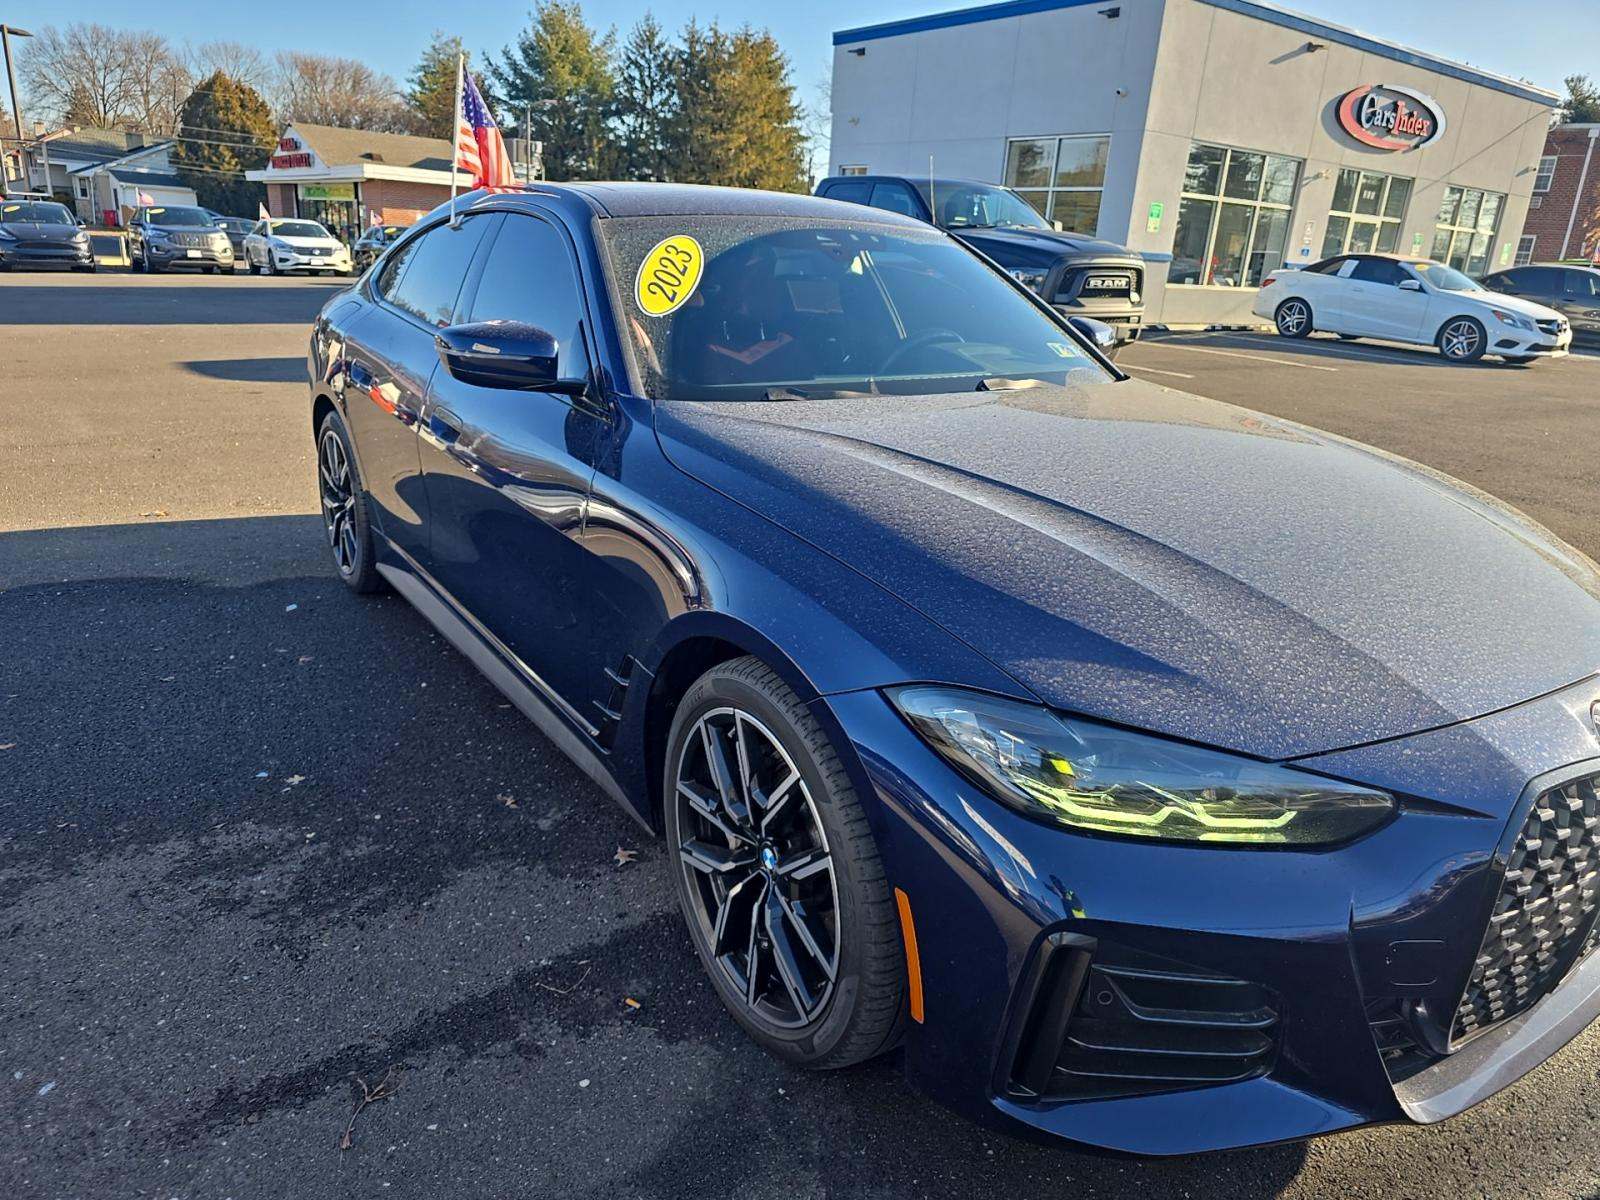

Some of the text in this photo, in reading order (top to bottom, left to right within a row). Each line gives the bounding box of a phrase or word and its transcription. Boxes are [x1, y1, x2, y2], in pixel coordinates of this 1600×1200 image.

[1361, 93, 1431, 137] CarsIndex
[647, 244, 693, 303] 2023
[1089, 279, 1127, 288] RAM
